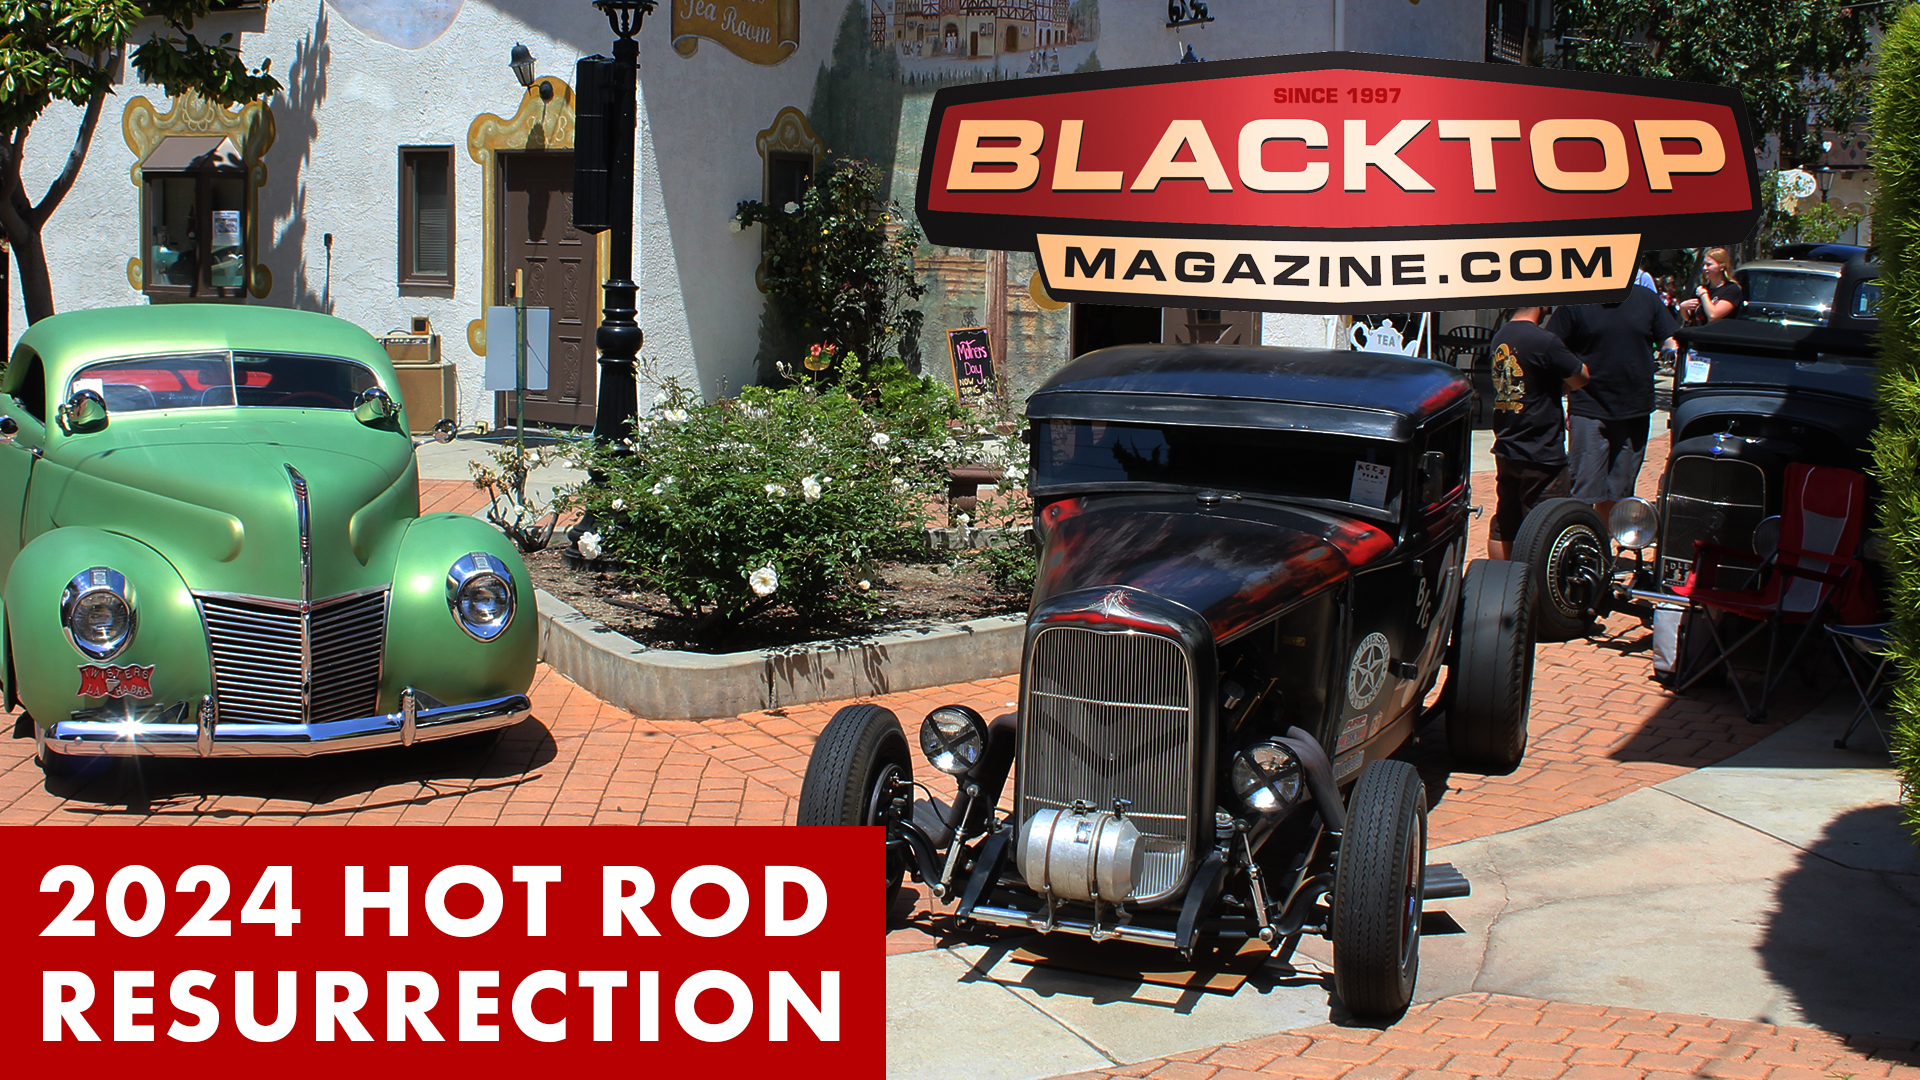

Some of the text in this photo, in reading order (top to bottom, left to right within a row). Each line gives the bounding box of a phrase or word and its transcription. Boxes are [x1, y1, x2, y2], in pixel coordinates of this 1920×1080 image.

[680, 0, 772, 44] Tea Room
[1377, 334, 1396, 347] TEA
[964, 361, 984, 385] Day
[82, 667, 149, 679] TWISTERS
[87, 684, 149, 696] LA HABRA
